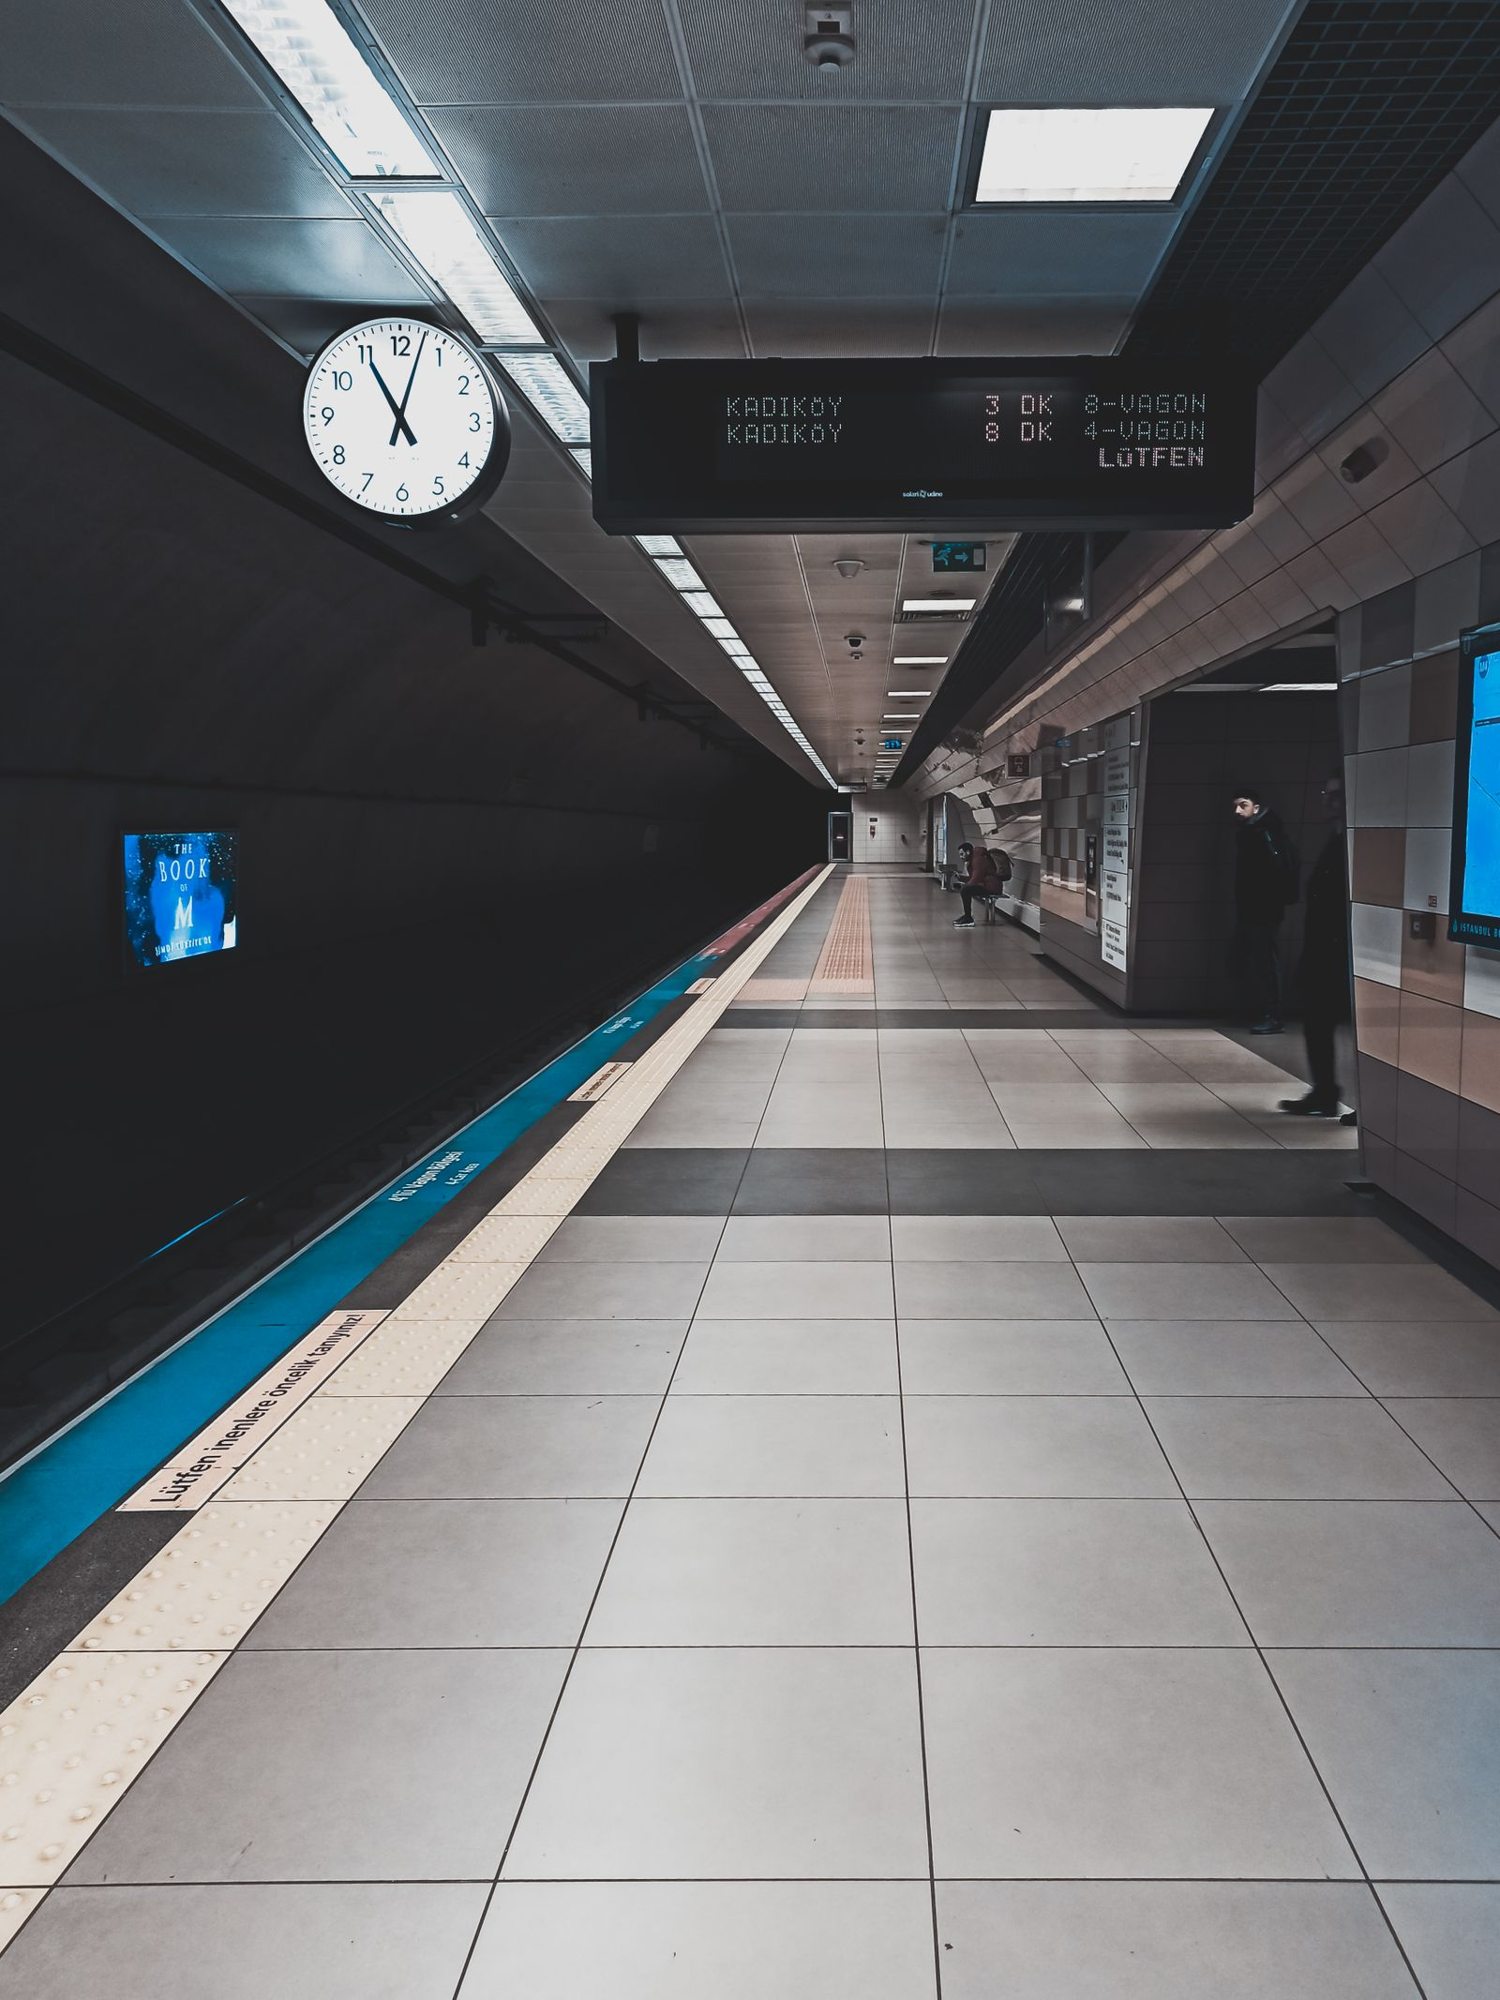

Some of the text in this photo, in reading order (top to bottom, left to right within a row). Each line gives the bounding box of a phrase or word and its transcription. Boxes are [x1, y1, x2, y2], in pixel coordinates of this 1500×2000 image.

[358, 345, 373, 364] 11
[390, 336, 411, 356] 12
[435, 348, 442, 367] 1
[332, 371, 353, 391] 10
[457, 375, 470, 395] 2
[727, 394, 1206, 417] KADIKÖY 3 DK 8-VAGON
[321, 407, 335, 426] 9
[469, 412, 481, 433] 3
[727, 420, 1205, 444] KADIKÖY 8 DK 4-VAGON
[333, 445, 346, 465] 8
[457, 451, 470, 469] 4
[361, 473, 374, 492] 7
[396, 482, 409, 502] 6
[432, 476, 444, 495] 5
[173, 843, 193, 855] THE
[158, 858, 208, 882] BOOK
[180, 883, 188, 892] OF
[174, 895, 194, 930] M
[150, 1451, 222, 1502] Lütfen
[204, 1398, 277, 1452] inenlere
[262, 1358, 320, 1397] öncelik
